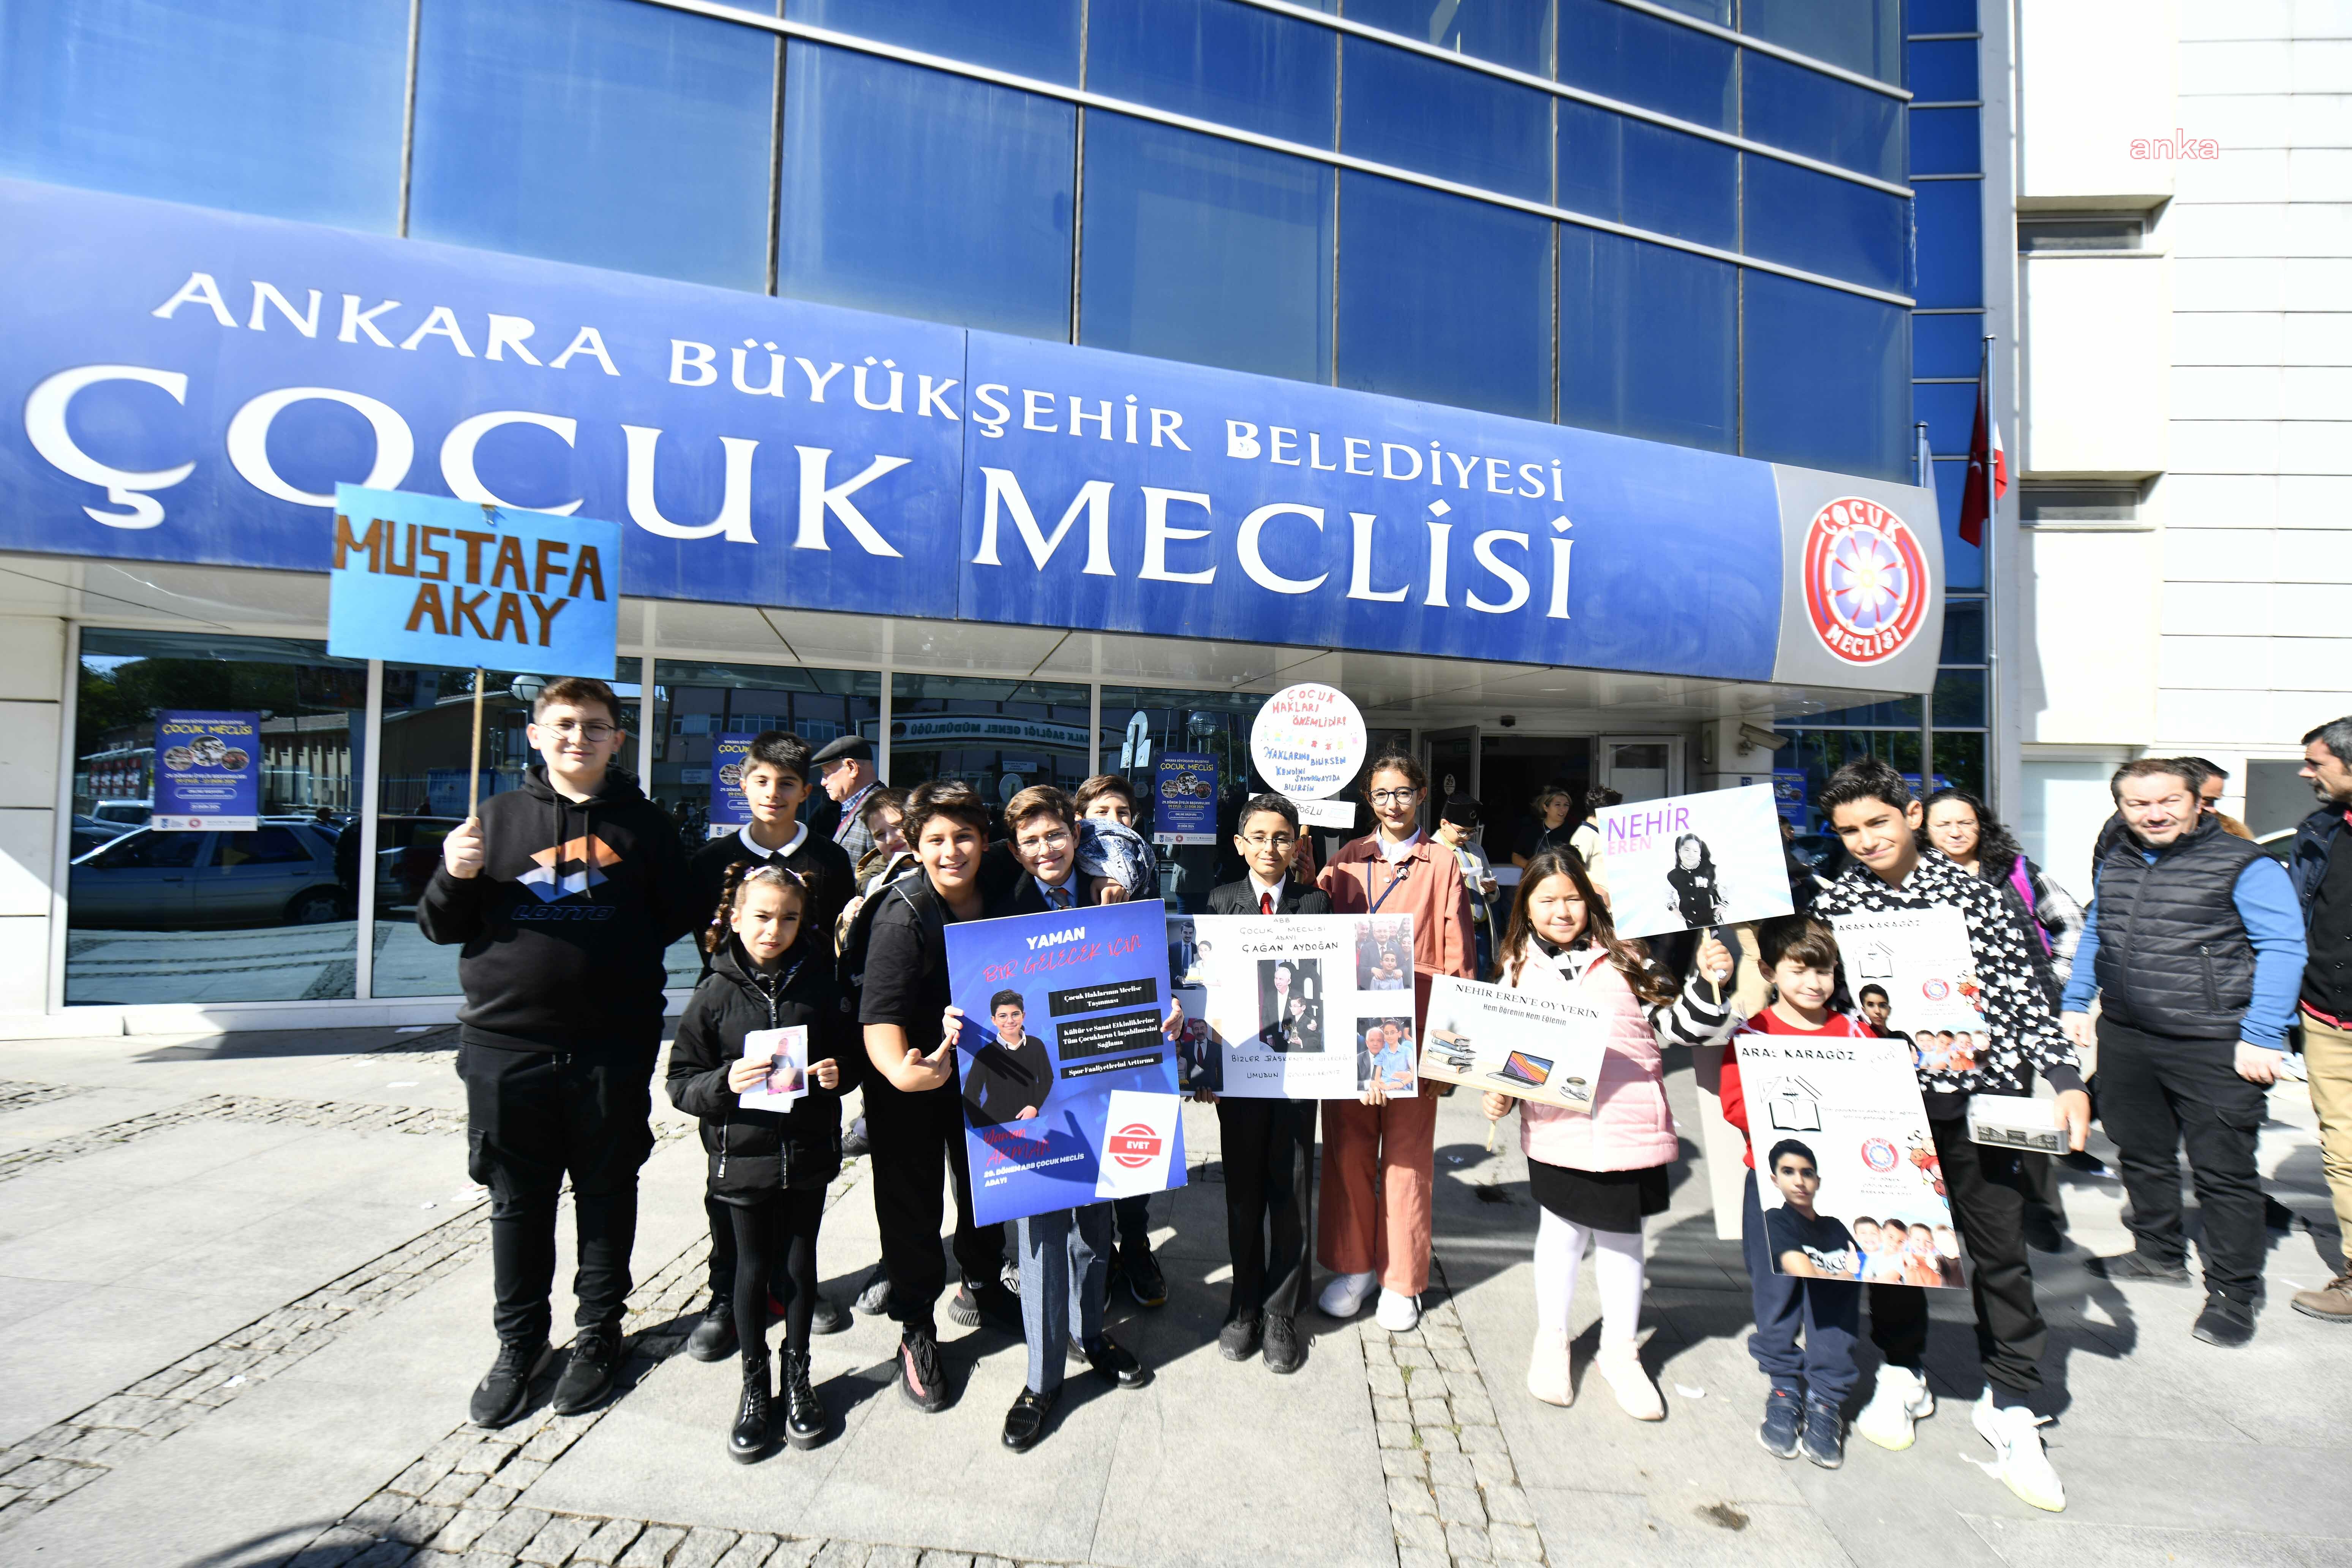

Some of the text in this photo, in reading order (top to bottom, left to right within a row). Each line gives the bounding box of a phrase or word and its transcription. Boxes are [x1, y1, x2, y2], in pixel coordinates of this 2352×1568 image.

[151, 272, 1565, 502] ANKARA BÜYÜKŞEHİR BELEDİYESİ
[24, 364, 1575, 620] ÇOCUK MECLİSİ
[335, 515, 606, 602] MUSTAFA
[405, 584, 570, 647] AKAY
[1273, 701, 1319, 714] HAKLARI
[1293, 715, 1346, 727] ÖNEMLİDİR!
[1608, 803, 1690, 841] NEHİR
[1607, 836, 1652, 856] EREN
[1026, 926, 1085, 950] YAMAN
[1242, 941, 1338, 953] ÇAĞAN AYDOĞAN
[982, 959, 1018, 982] BİR
[1023, 942, 1101, 975] GELECEK
[1064, 993, 1084, 1002] Çocuk
[1084, 989, 1119, 999] Haklarının
[1087, 998, 1119, 1007] Taşınması
[1455, 984, 1599, 1019] NEHİR EREN'E OY VERİN
[1483, 1003, 1567, 1026] Hem Öğrenin Hem Eğlenin
[1078, 1032, 1113, 1043] Çocukların
[1113, 1025, 1158, 1037] Ulaşabilmesini
[1094, 1023, 1111, 1032] Sanat
[1113, 1018, 1155, 1028] Etkinliklerine
[1097, 1040, 1124, 1049] Sağlama
[1785, 1048, 1856, 1061] KARAGÖZ
[1069, 1057, 1154, 1076] Spor Faaliyetlerini Arttırma
[1126, 1141, 1150, 1149] EVET
[996, 1164, 1021, 1176] DÖNEM
[1021, 1162, 1035, 1171] ABB
[1036, 1157, 1060, 1169] ÇOCUK
[1060, 1151, 1085, 1163] MECLİS
[985, 1177, 1007, 1187] ADAYI
